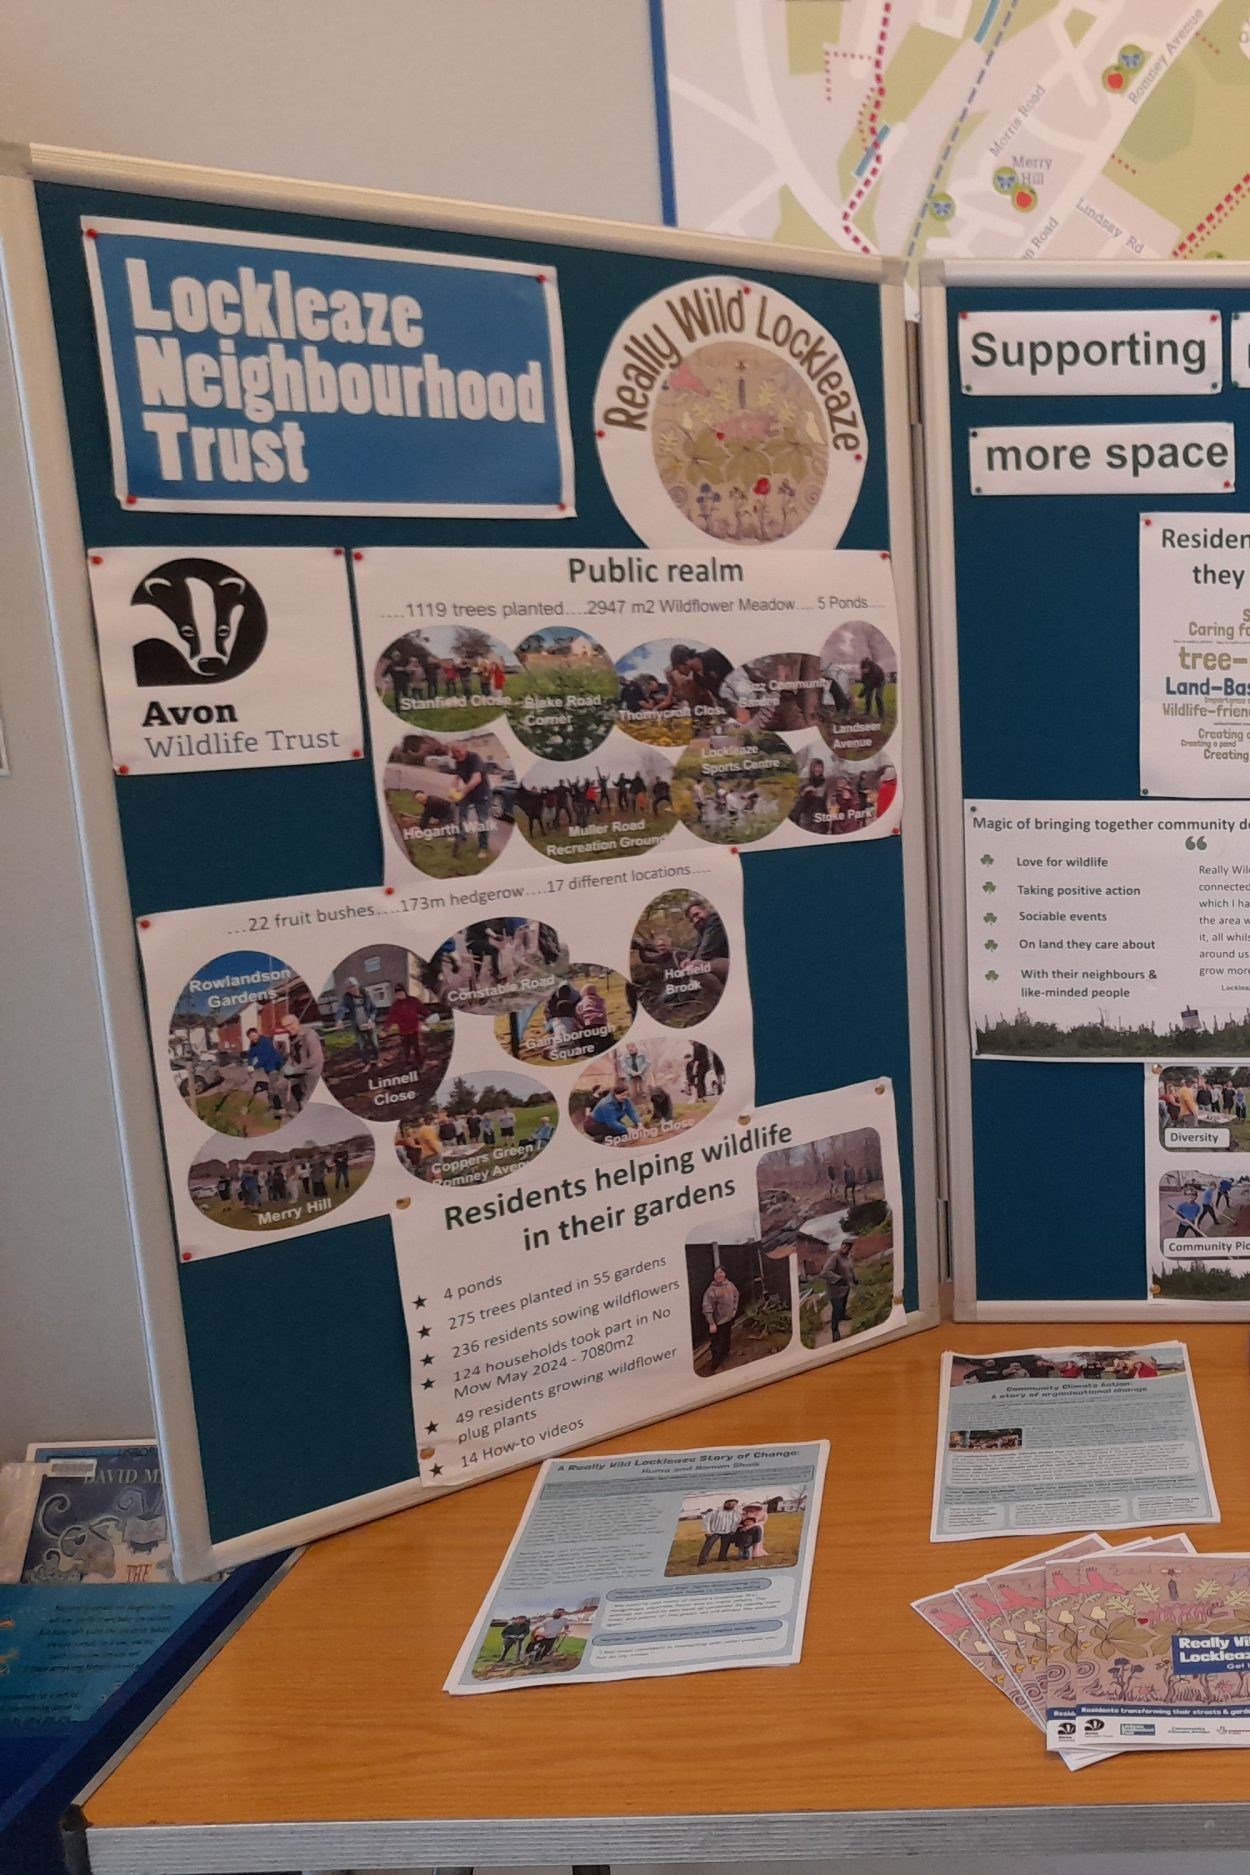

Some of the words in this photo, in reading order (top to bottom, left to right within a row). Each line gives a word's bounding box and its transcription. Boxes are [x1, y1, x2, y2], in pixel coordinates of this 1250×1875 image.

[1128, 53, 1169, 104] Romney
[1165, 9, 1204, 55] Avenue
[990, 117, 1021, 157] Morris
[1020, 86, 1046, 118] Road
[1013, 156, 1052, 170] Merry
[1021, 173, 1044, 185] Hill
[125, 258, 423, 348] Lockleaze
[971, 331, 1205, 375] Supporting
[134, 337, 545, 423] Neighbourhood
[604, 324, 683, 431] Really
[666, 288, 745, 342] Wild
[757, 296, 860, 451] Lockleaze
[142, 412, 308, 483] Trust
[987, 445, 1090, 471] more
[1106, 443, 1228, 477] space
[569, 557, 658, 583] Public
[668, 557, 743, 582] realm
[1193, 564, 1245, 589] they
[142, 701, 238, 727] Avon
[144, 731, 258, 758] Wildlife
[267, 730, 340, 750] Trust
[973, 817, 1012, 831] Magic
[1017, 818, 1030, 829] of
[1035, 818, 1090, 832] bringing
[1095, 818, 1154, 832] together
[1158, 818, 1235, 832] community
[1199, 865, 1228, 876] Really
[189, 965, 290, 994] Rowlandson
[208, 988, 278, 1009] Gardens
[368, 1071, 418, 1092] Linnell
[374, 1088, 415, 1107] Close
[1171, 1133, 1218, 1143] Diversity
[444, 1175, 587, 1231] Residents
[594, 1148, 696, 1189] helping
[702, 1123, 793, 1163] wildlife
[523, 1228, 550, 1251] in
[557, 1206, 626, 1243] their
[634, 1176, 736, 1226] gardens
[1169, 1242, 1232, 1252] Community
[443, 1287, 453, 1301] 4
[457, 1272, 503, 1299] ponds
[448, 1314, 475, 1331] 275
[479, 1301, 516, 1322] trees
[519, 1283, 573, 1311] planted
[575, 1276, 590, 1291] in
[592, 1270, 610, 1286] 55
[613, 1254, 667, 1286] gardens
[1179, 1637, 1230, 1650] Really
